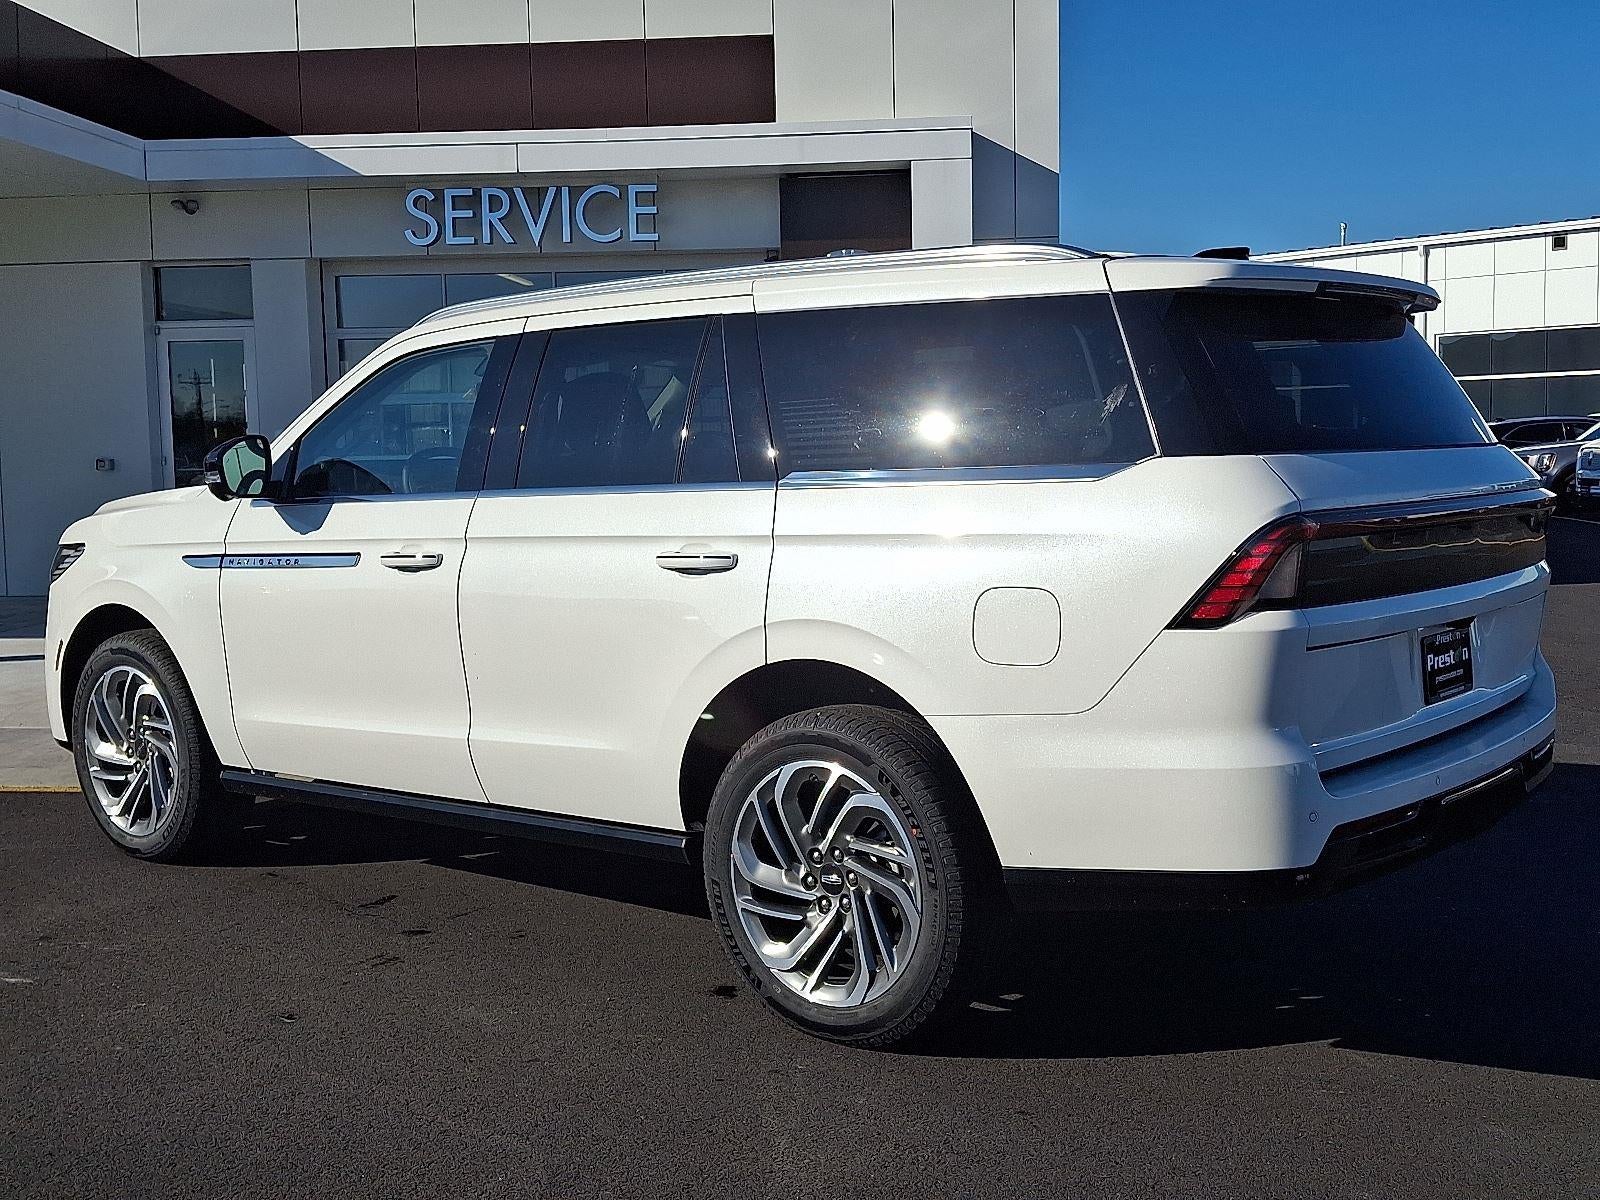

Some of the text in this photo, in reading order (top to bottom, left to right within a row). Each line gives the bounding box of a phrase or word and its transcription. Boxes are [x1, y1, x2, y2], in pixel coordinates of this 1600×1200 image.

[404, 184, 660, 248] SERVICE
[228, 558, 301, 566] NAVIGATOR
[1435, 631, 1461, 645] Prestn
[895, 793, 939, 888] MICHELIN
[711, 879, 752, 970] MICHELIN
